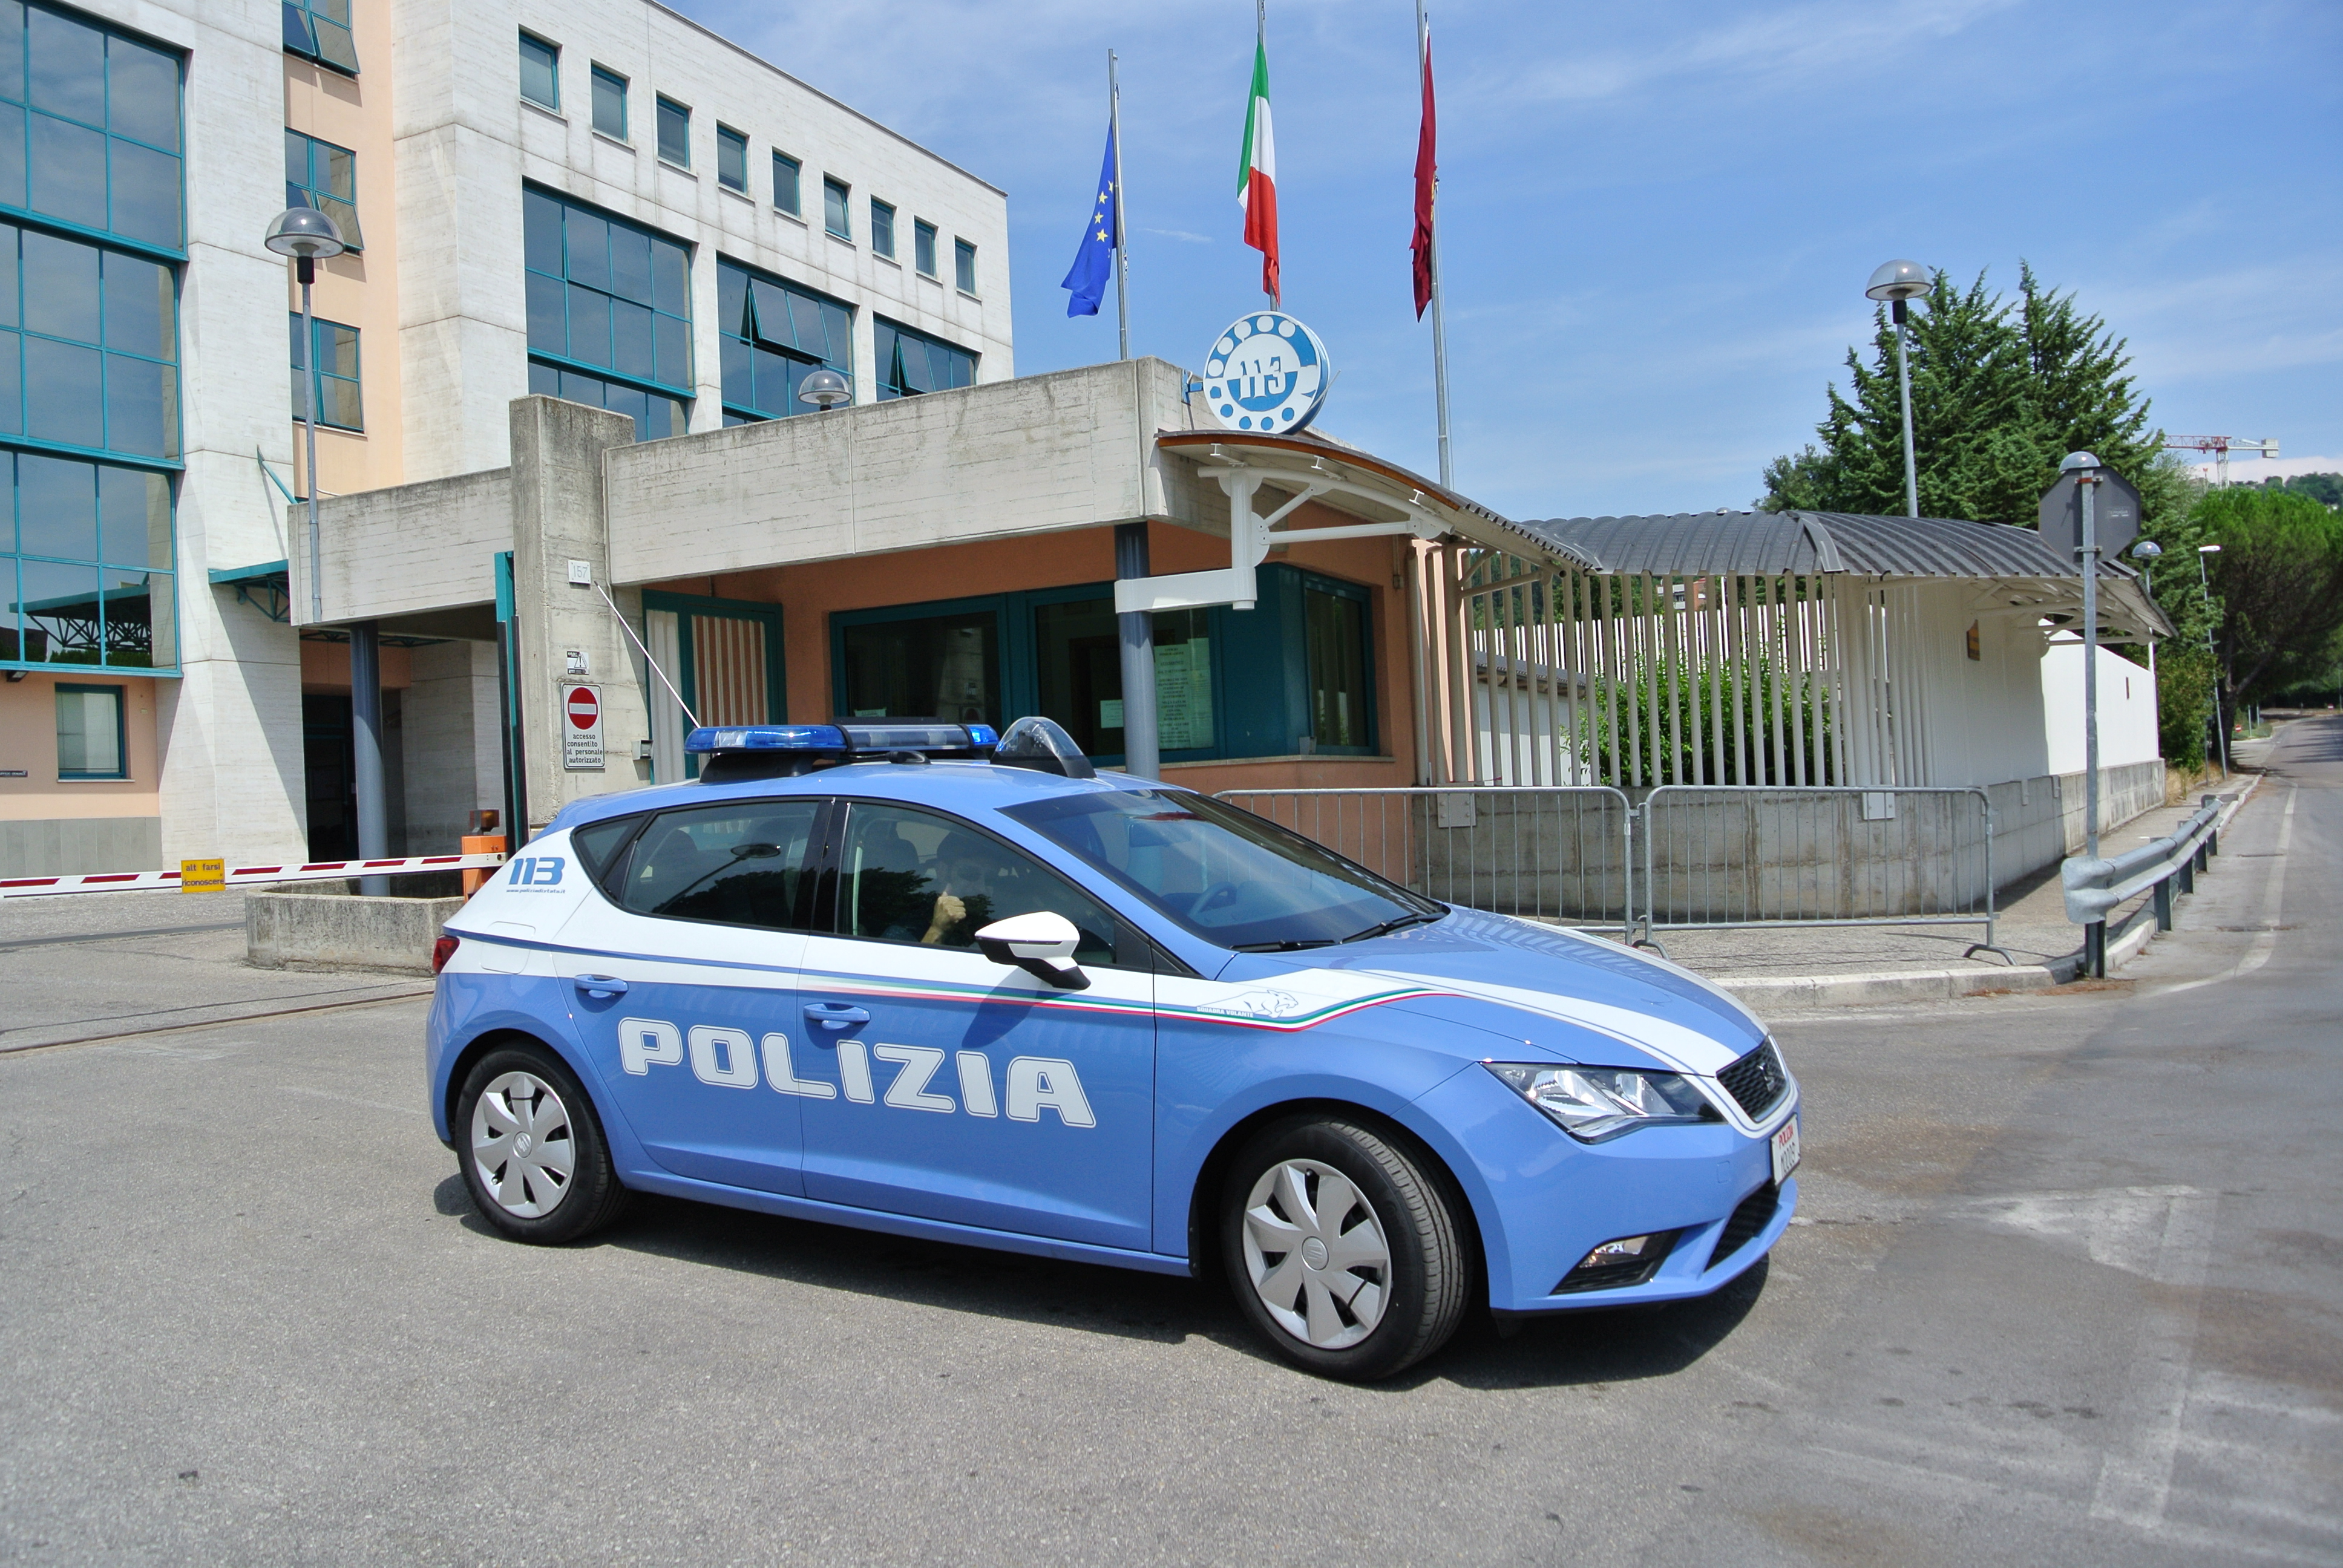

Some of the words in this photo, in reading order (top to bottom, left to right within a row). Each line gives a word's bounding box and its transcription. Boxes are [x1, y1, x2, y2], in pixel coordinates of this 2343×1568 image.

[1239, 356, 1286, 400] 113
[574, 566, 588, 578] 157
[509, 857, 566, 885] 113
[1196, 1006, 1225, 1014] SQUADRA
[1226, 1010, 1254, 1018] VOLANTE
[618, 1016, 1097, 1128] POLIZIA
